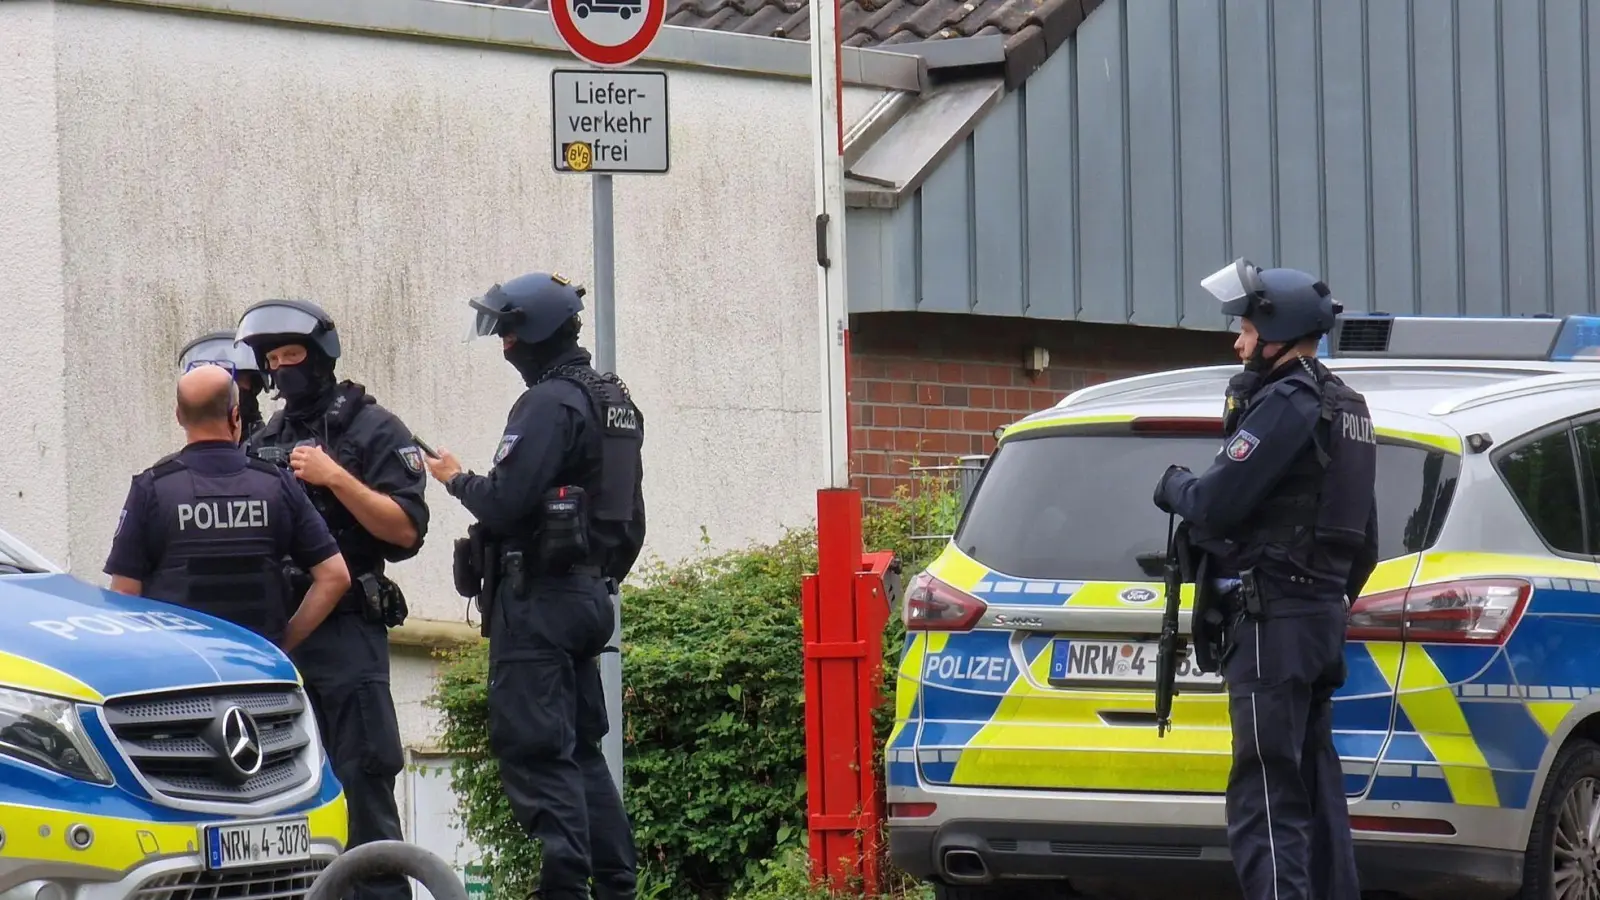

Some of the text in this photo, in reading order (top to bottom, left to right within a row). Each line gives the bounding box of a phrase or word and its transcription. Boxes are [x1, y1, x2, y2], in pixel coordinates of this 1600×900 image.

[575, 81, 646, 104] Liefer-
[568, 110, 652, 133] verkehr
[570, 145, 588, 164] BVB
[593, 139, 628, 161] frei
[1342, 411, 1376, 445] POLIZE
[177, 500, 268, 531] POLIZEI
[1127, 590, 1150, 601] Ford
[29, 610, 214, 641] POLIZEI
[925, 655, 1011, 681] POLIZEI
[1055, 662, 1062, 672] D
[1067, 644, 1118, 675] NRW
[220, 829, 251, 861] NRW
[261, 823, 308, 857] 4-3078
